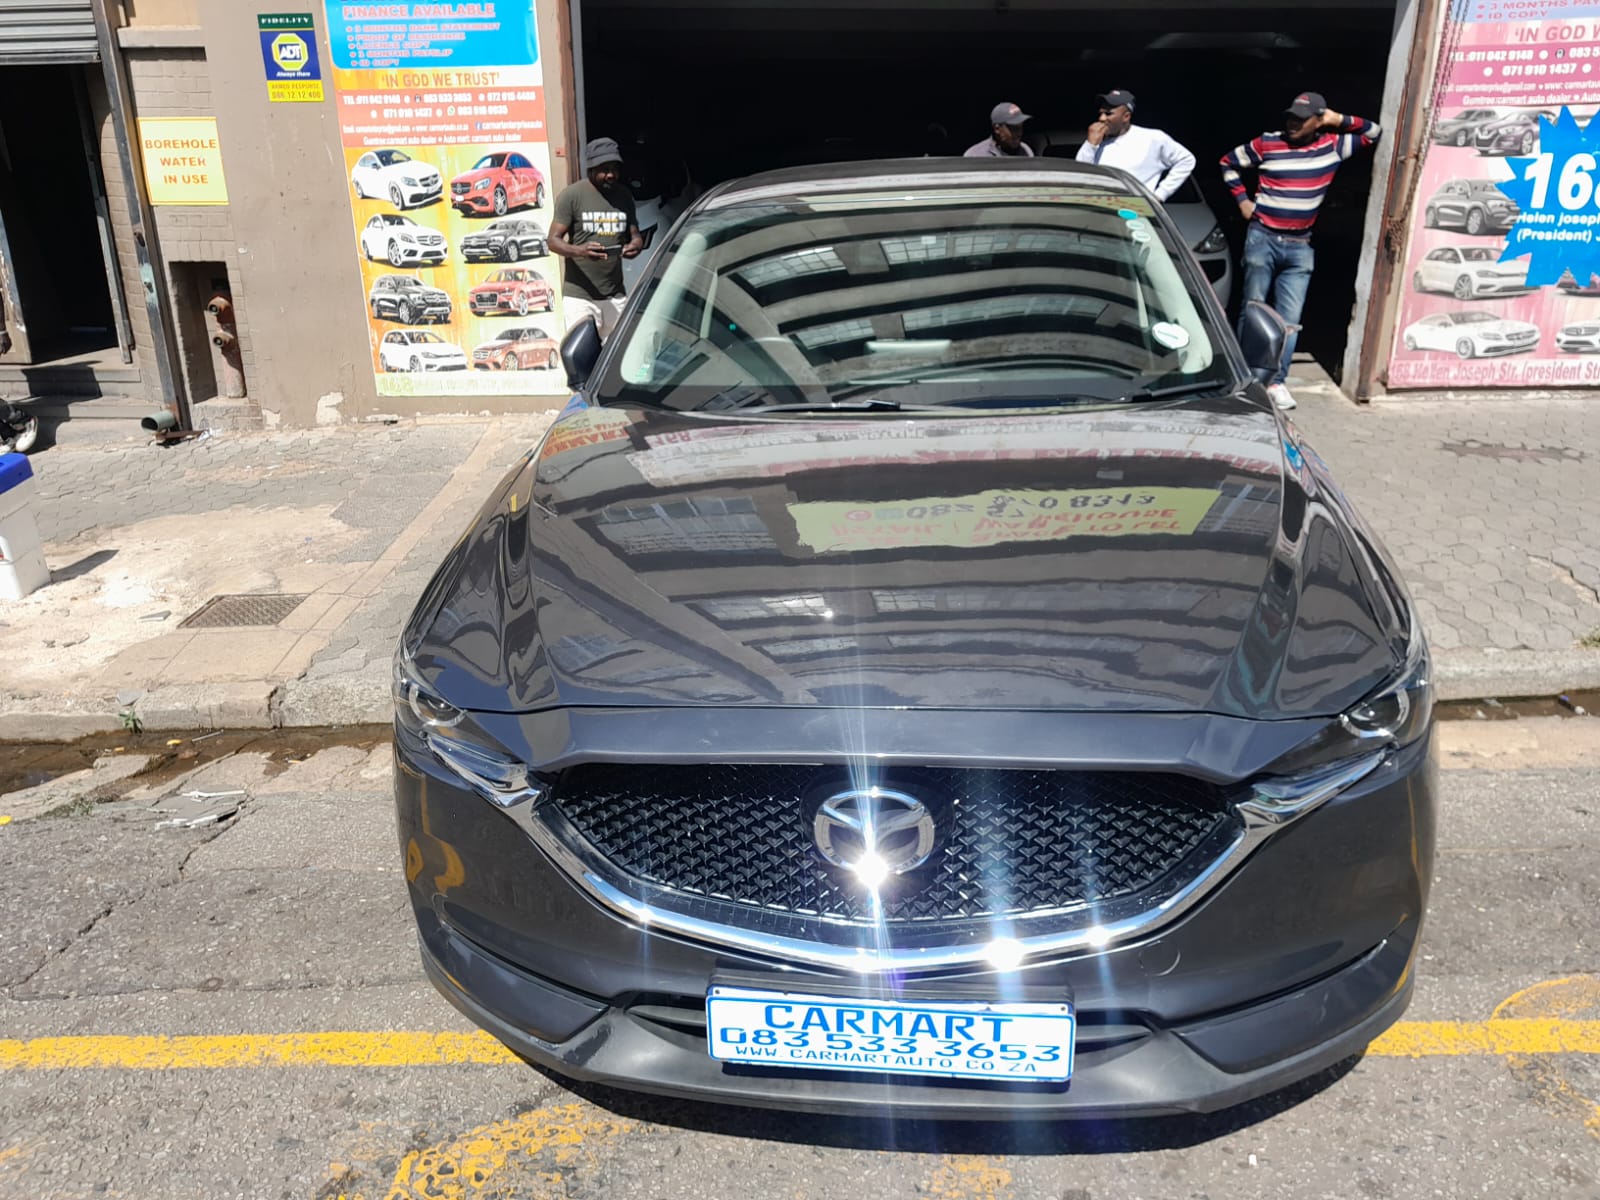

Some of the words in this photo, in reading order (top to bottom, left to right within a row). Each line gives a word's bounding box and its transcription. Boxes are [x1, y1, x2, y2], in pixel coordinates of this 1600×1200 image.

[343, 5, 409, 18] FINANCE
[414, 3, 496, 17] AVAILABLE
[1503, 0, 1568, 9] MONTHS
[261, 17, 310, 25] FIDELITY
[1488, 12, 1503, 20] ID
[1508, 9, 1548, 19] COPY
[1545, 24, 1586, 41] GOD
[279, 45, 302, 60] ADT
[403, 73, 430, 88] GOD
[432, 72, 453, 87] WE
[287, 91, 296, 99] 12
[298, 91, 306, 99] 12
[145, 139, 217, 149] BOREHOLE
[163, 174, 178, 185] IN
[182, 174, 209, 184] USE
[1524, 152, 1600, 211] 16
[1453, 361, 1496, 384] Joseph
[765, 1004, 1013, 1042] CARMART
[720, 1027, 810, 1048] 083
[826, 1033, 918, 1054] 533
[934, 1039, 1061, 1062] 3653
